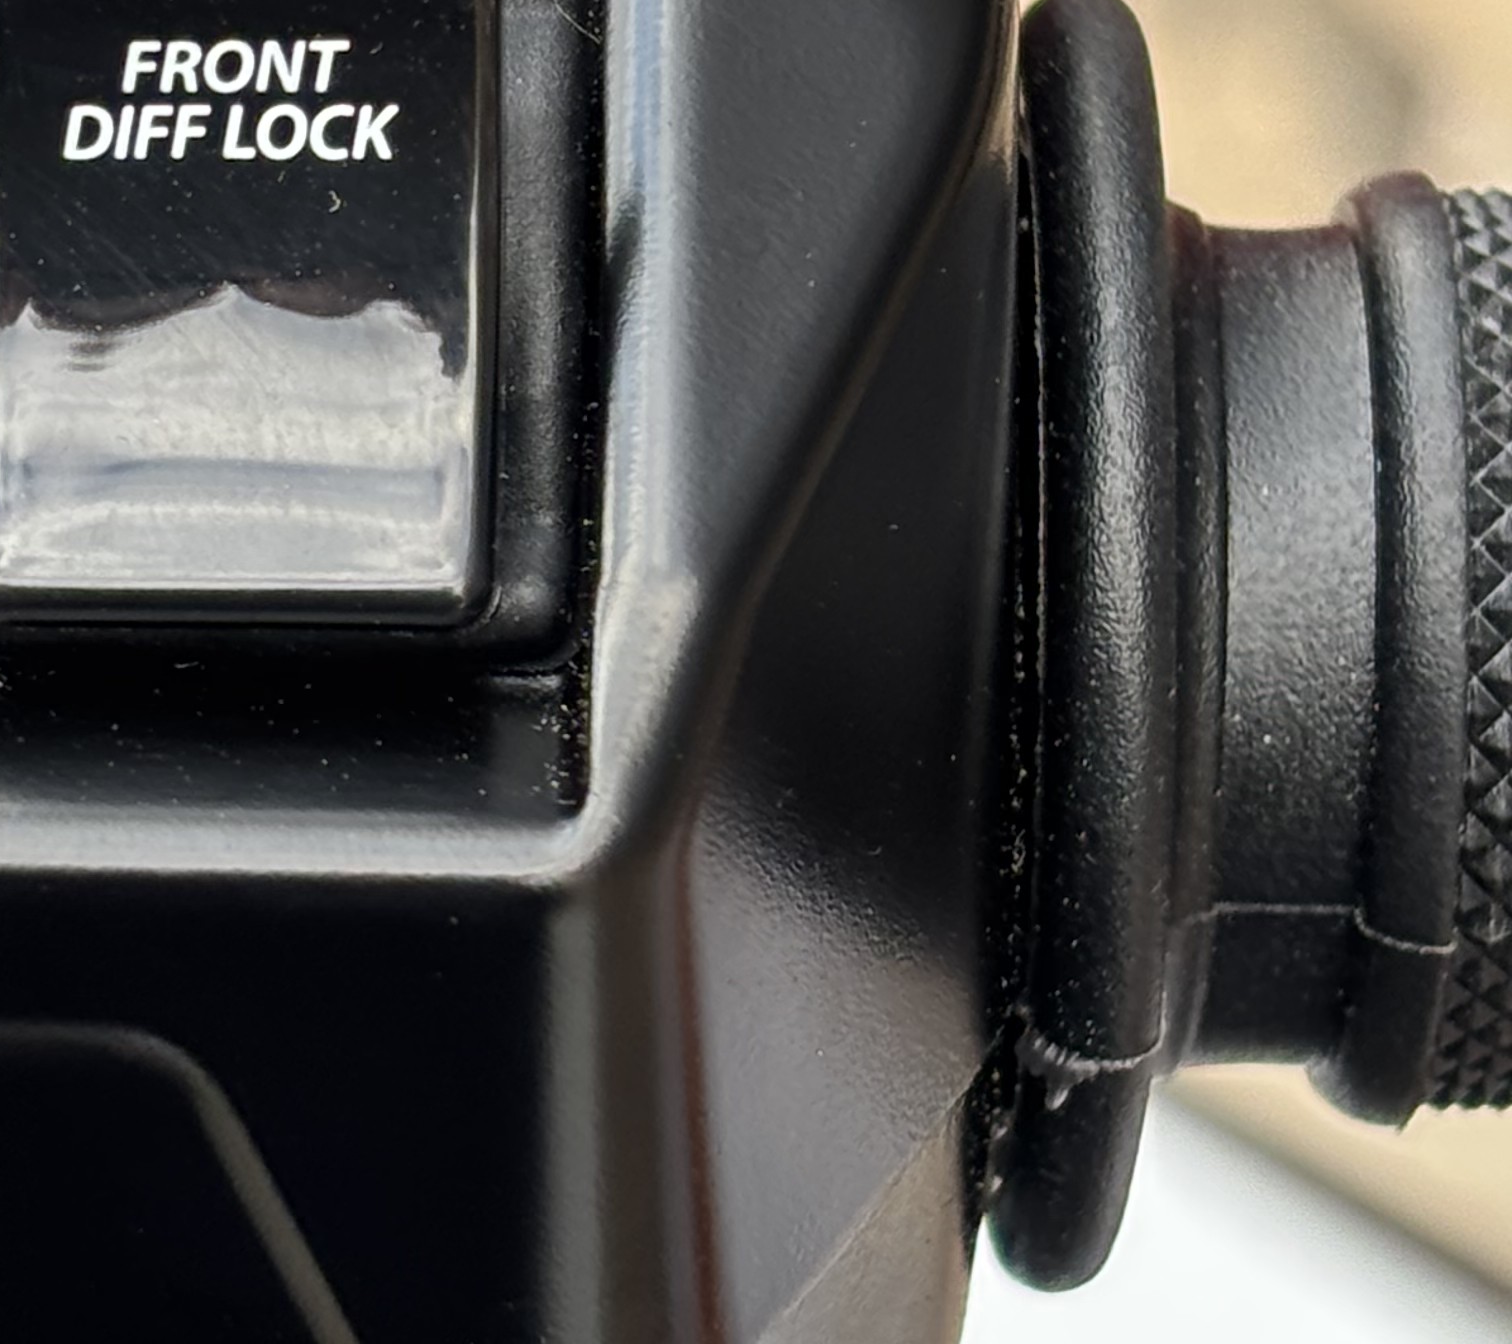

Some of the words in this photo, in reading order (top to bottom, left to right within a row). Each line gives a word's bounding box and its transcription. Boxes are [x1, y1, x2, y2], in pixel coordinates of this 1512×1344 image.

[121, 39, 351, 94] FRONT
[62, 103, 213, 161] DIFF
[222, 103, 400, 162] LOCK
